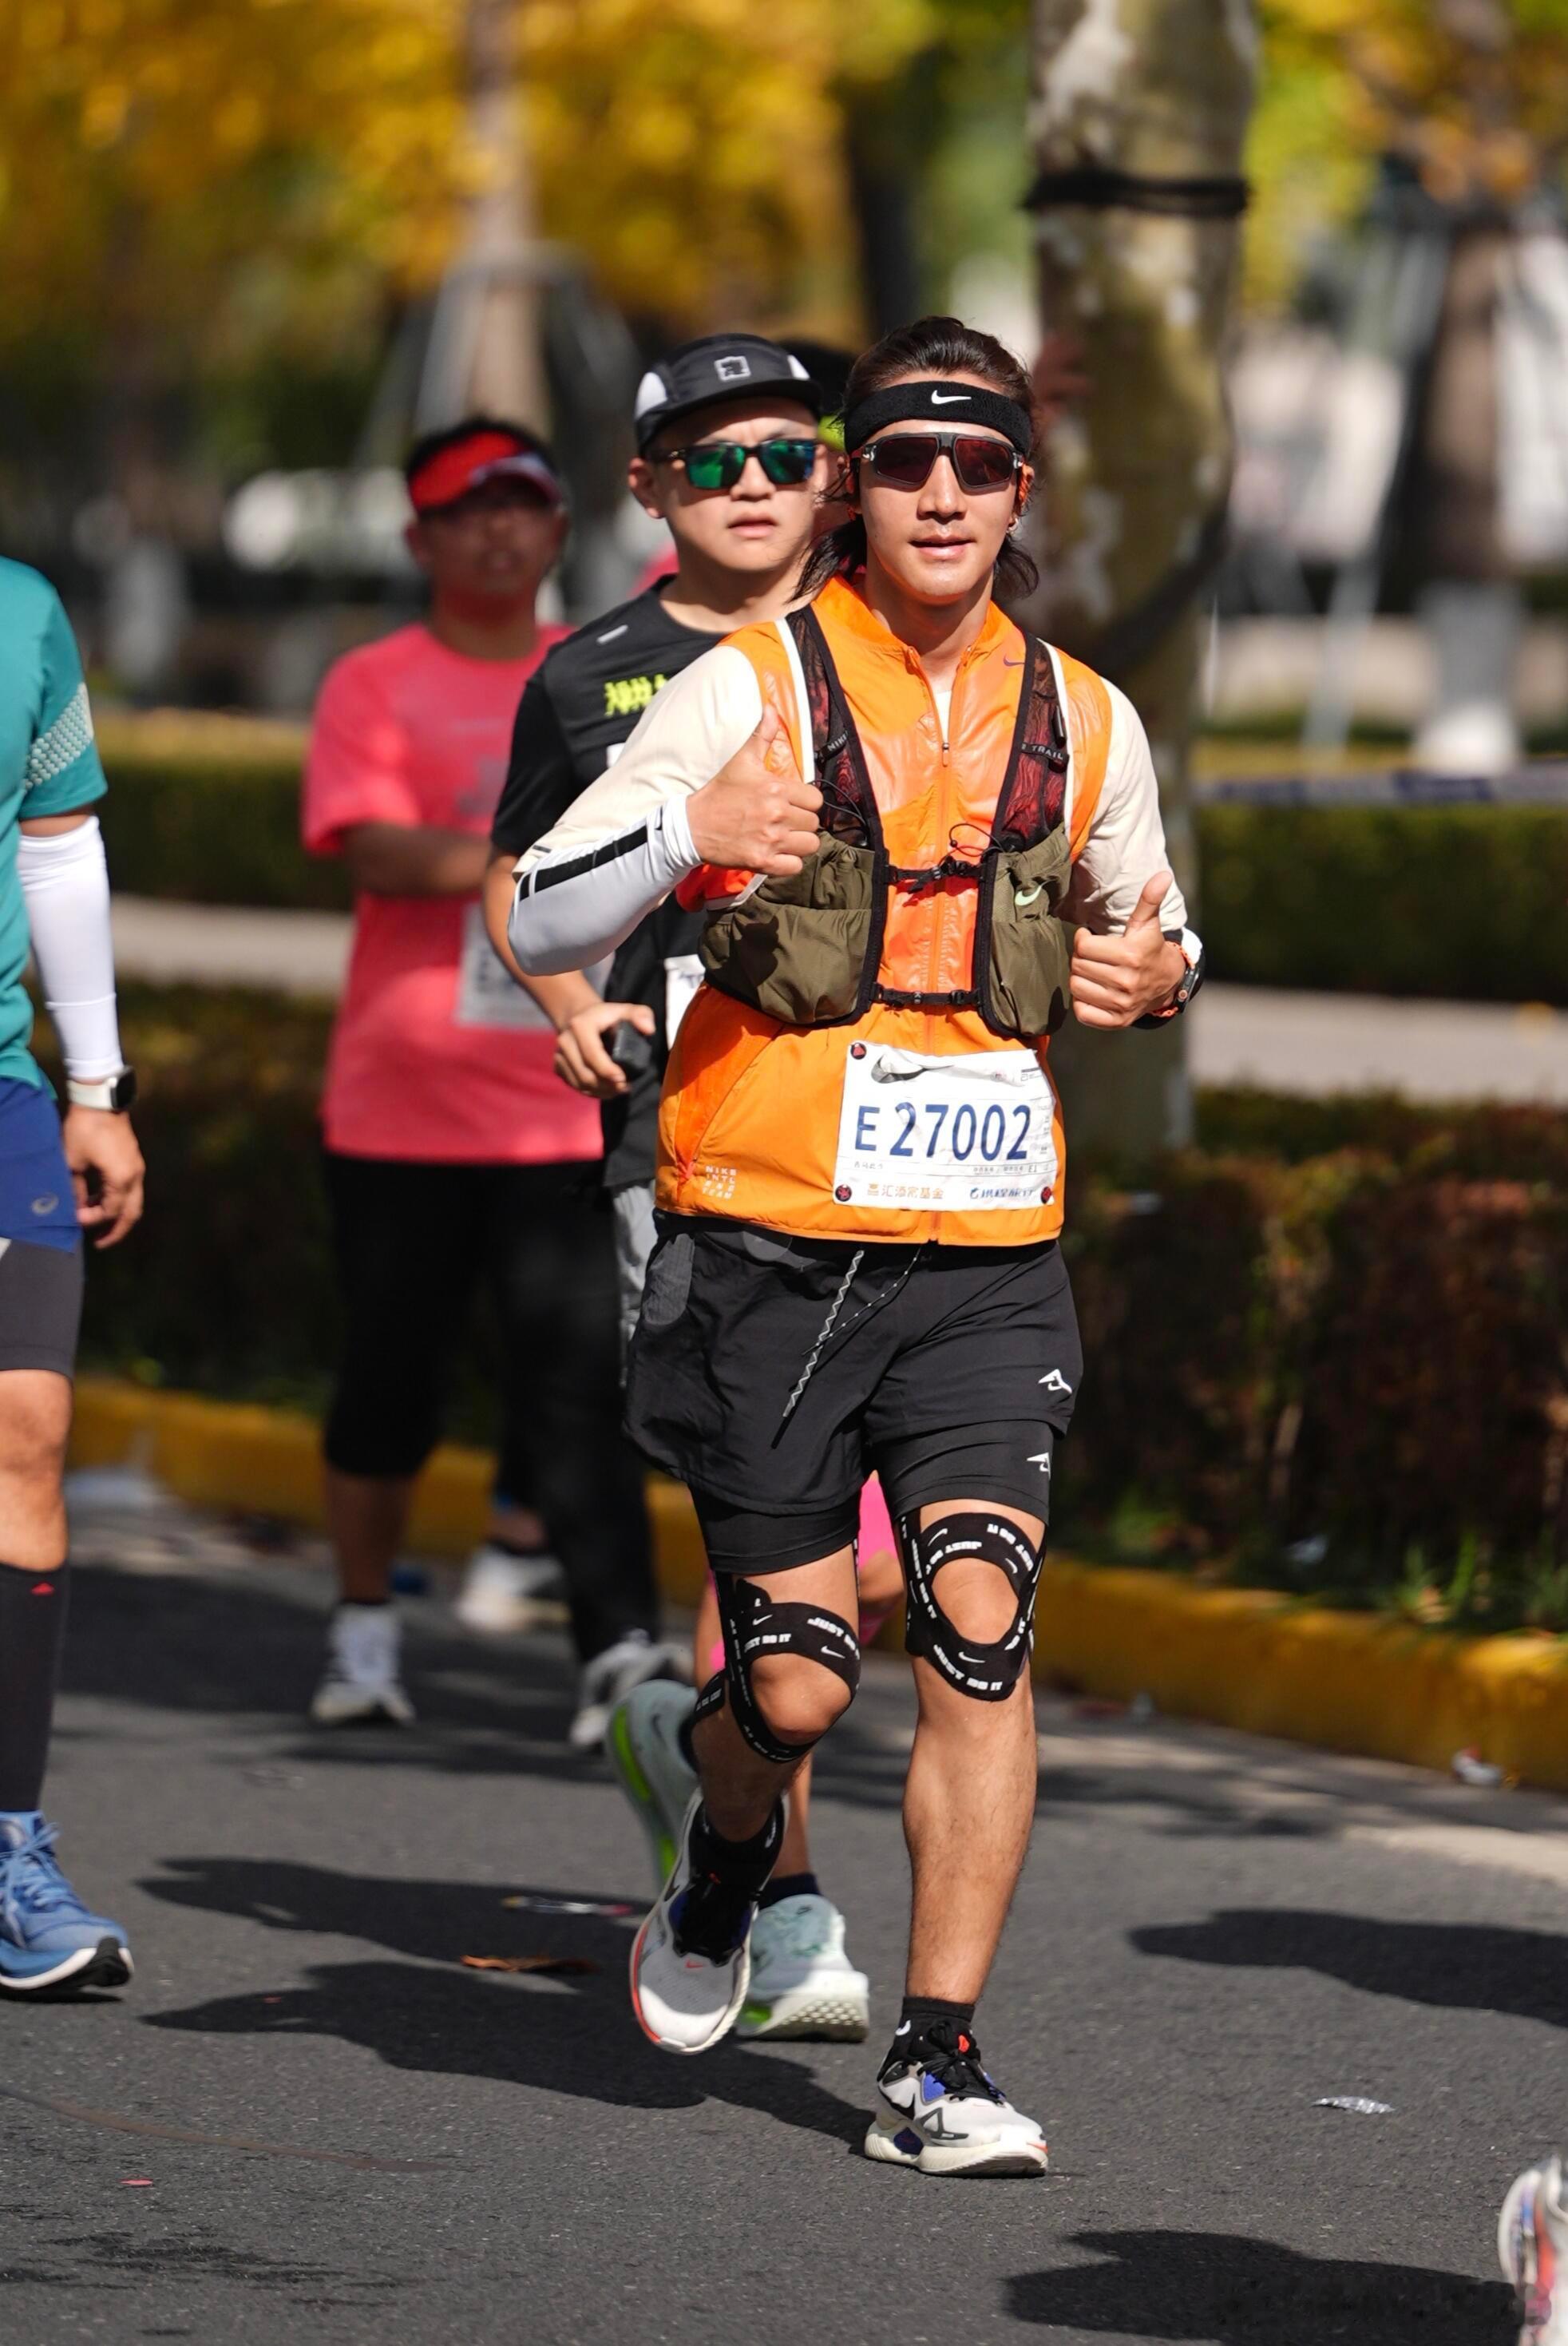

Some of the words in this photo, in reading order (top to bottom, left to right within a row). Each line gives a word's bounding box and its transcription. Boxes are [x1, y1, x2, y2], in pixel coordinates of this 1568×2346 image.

[1031, 745, 1064, 761] TRAIL
[854, 1101, 1032, 1161] E27002
[705, 1165, 737, 1176] NIKE
[806, 1616, 845, 1638] JUST
